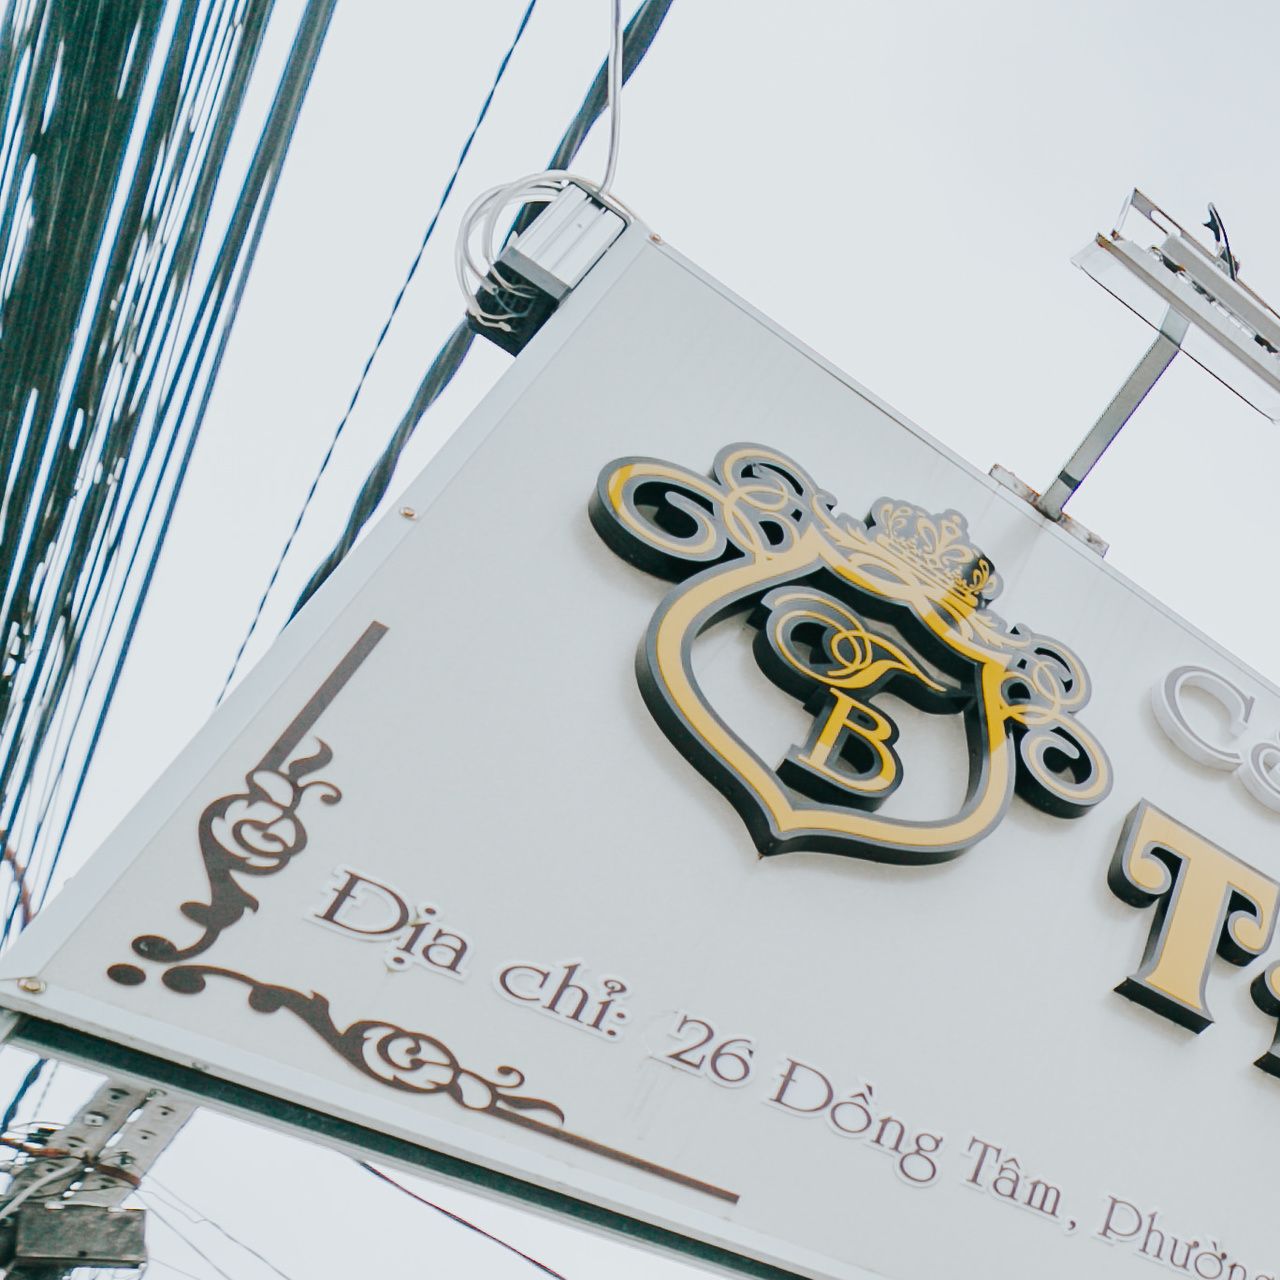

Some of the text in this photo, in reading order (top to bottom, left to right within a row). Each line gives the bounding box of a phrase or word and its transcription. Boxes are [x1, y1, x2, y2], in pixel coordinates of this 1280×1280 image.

[314, 869, 469, 975] Địa
[499, 962, 627, 1037] chỉ:
[667, 1012, 755, 1083] 26
[768, 1057, 944, 1184] Đồng
[965, 1135, 1078, 1231] Tâm,
